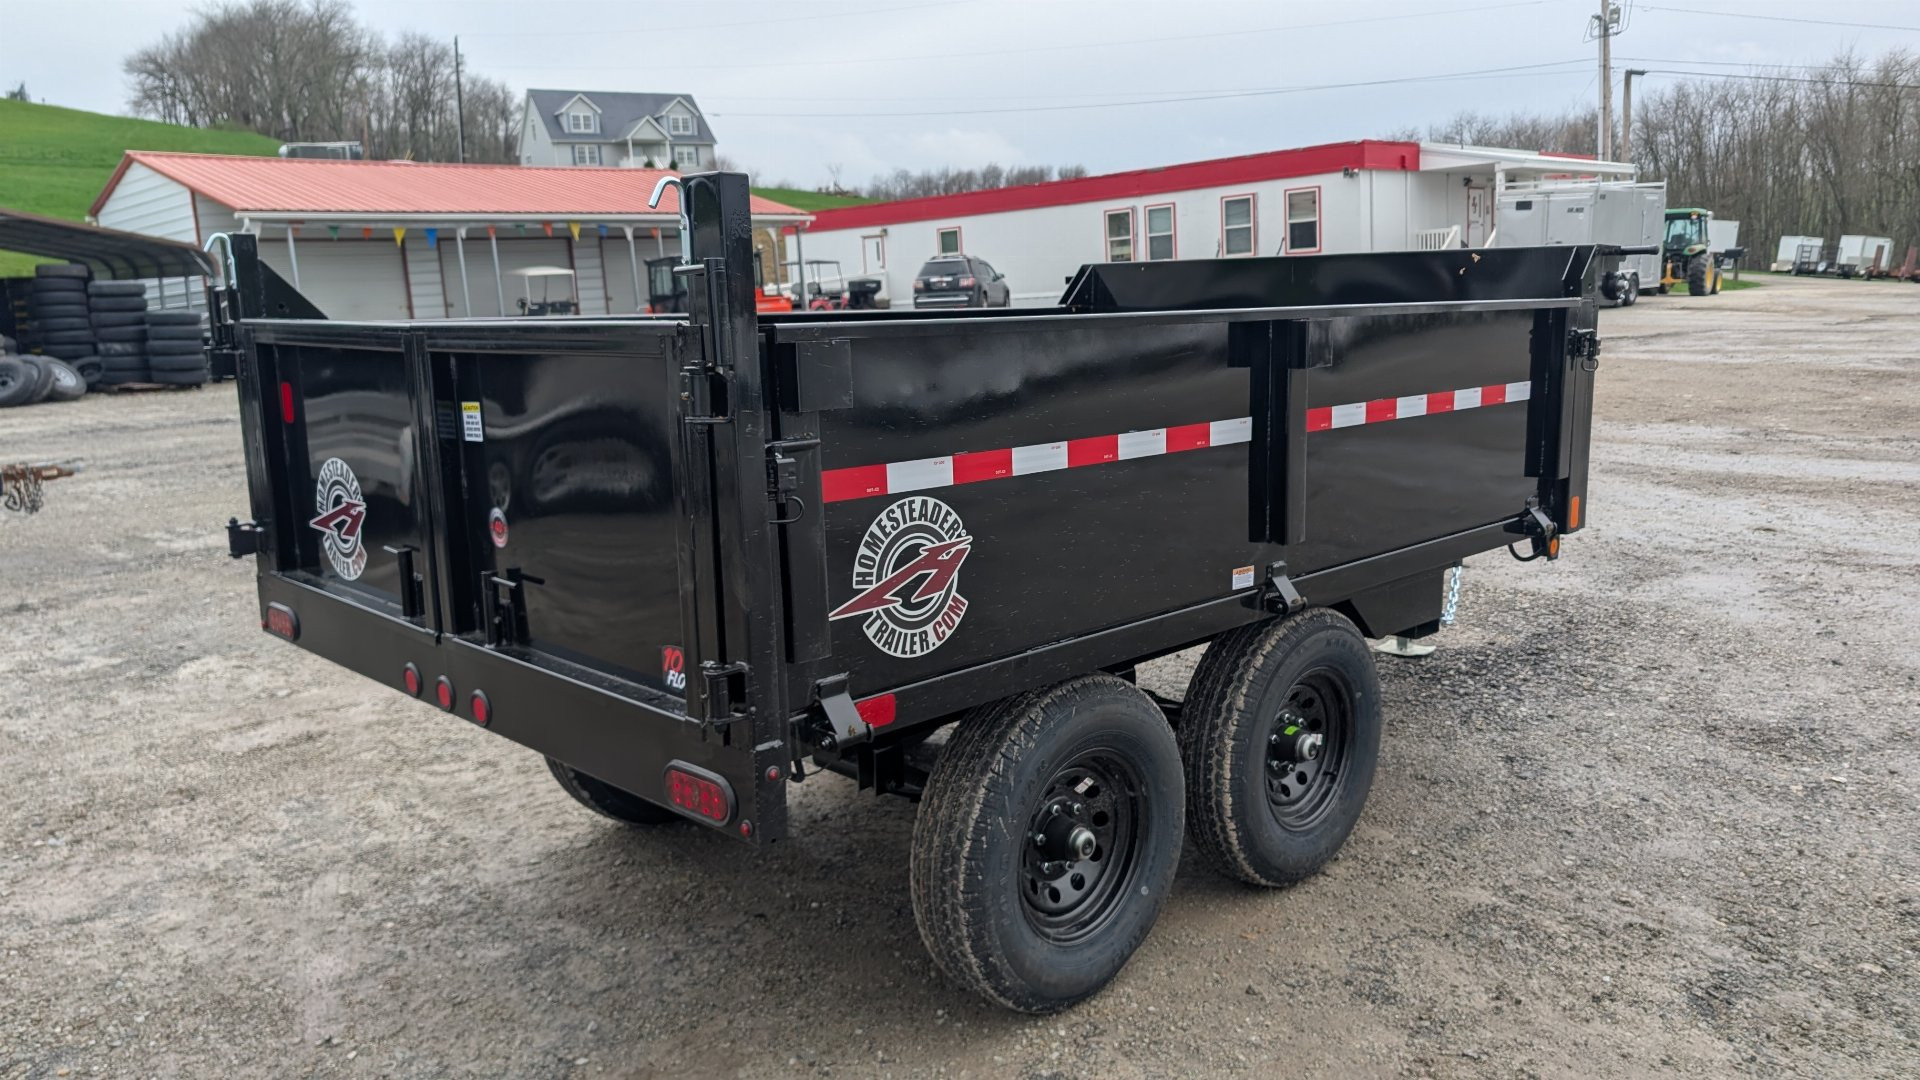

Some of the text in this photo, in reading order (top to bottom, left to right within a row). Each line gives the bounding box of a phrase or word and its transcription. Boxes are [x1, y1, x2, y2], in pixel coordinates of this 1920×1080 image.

[854, 499, 962, 587] HOMESTEADER
[865, 595, 967, 655] TRAILER.COM
[663, 647, 684, 672] 10
